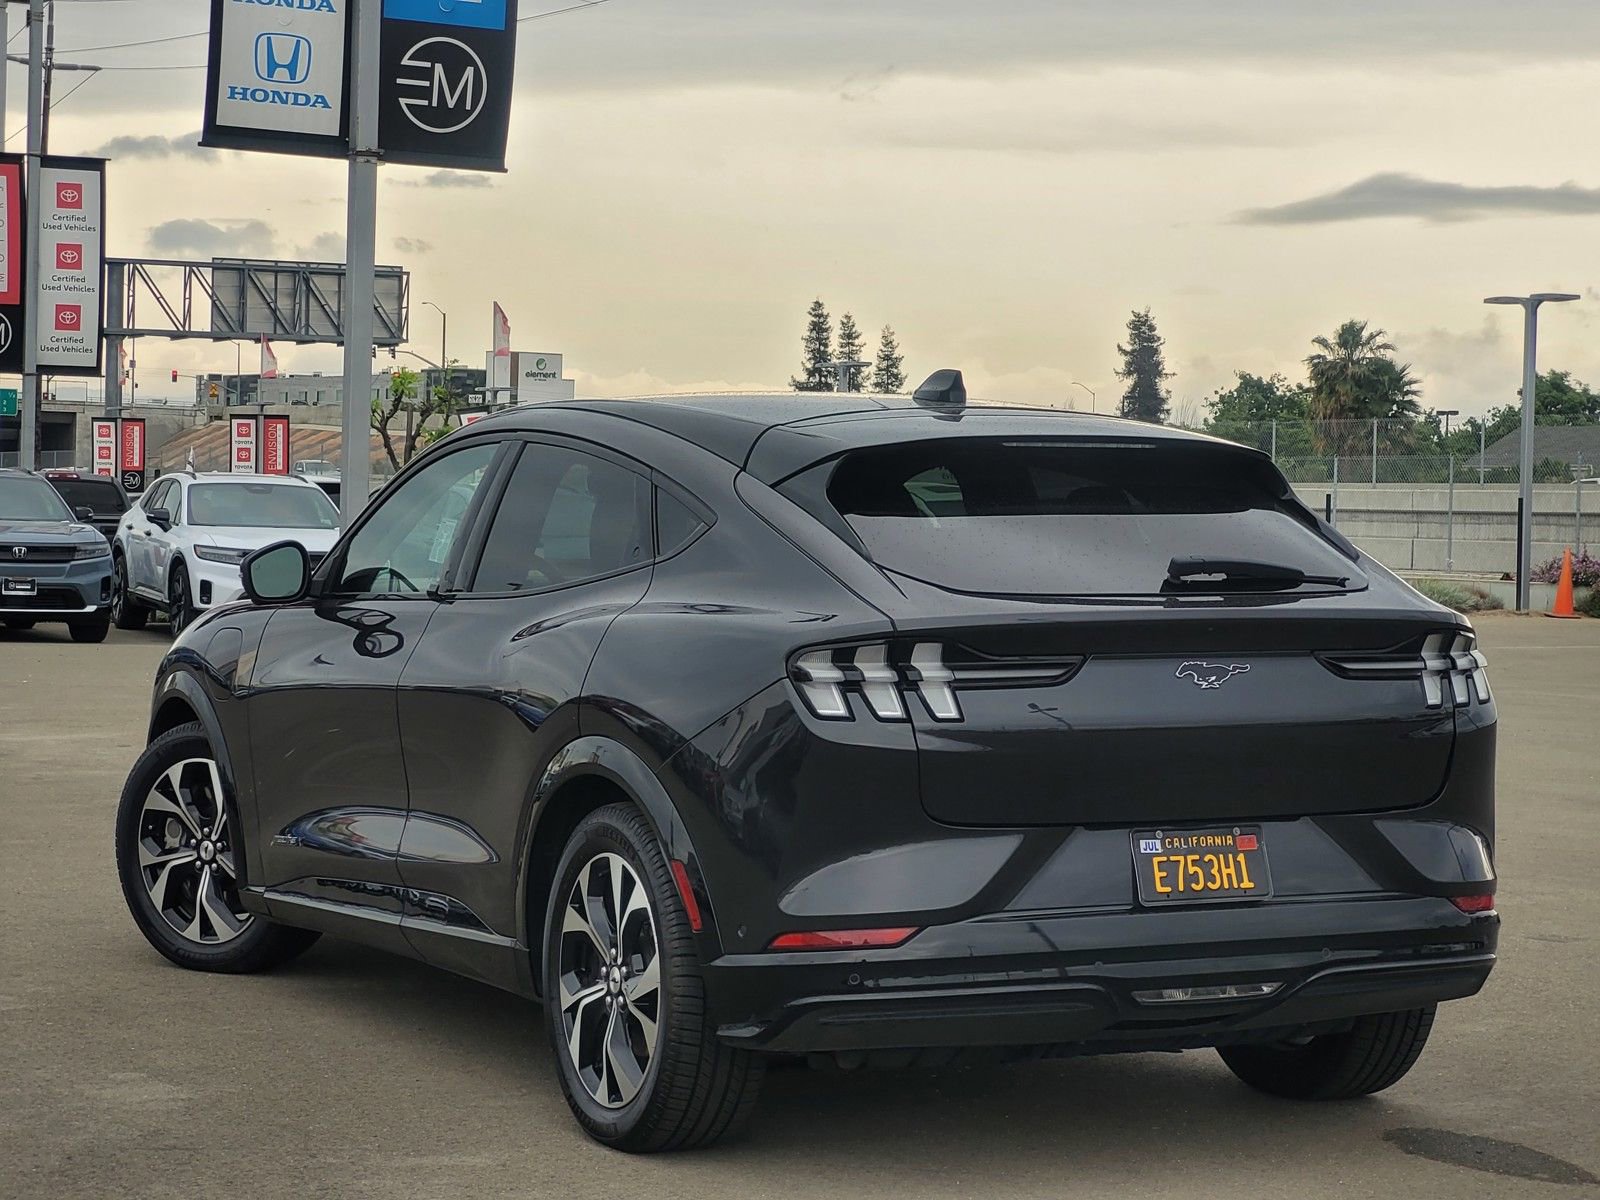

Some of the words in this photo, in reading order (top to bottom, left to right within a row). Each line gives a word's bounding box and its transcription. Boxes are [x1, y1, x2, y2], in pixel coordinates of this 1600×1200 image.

[227, 85, 332, 109] HONDA
[52, 213, 87, 222] Certified
[42, 222, 62, 231] Used
[64, 223, 97, 232] Vehicles
[51, 274, 86, 283] Certified
[41, 284, 62, 292] Used
[63, 284, 96, 293] Vehicles
[50, 335, 84, 344] Certified
[40, 344, 60, 353] Used
[61, 345, 93, 354] Vehicles
[526, 370, 557, 378] element
[126, 425, 134, 467] ENVISION
[268, 423, 277, 471] ENVISION
[1142, 841, 1160, 852] JUL
[1165, 835, 1234, 849] CALIFORNIA
[1152, 853, 1255, 893] E753H1
